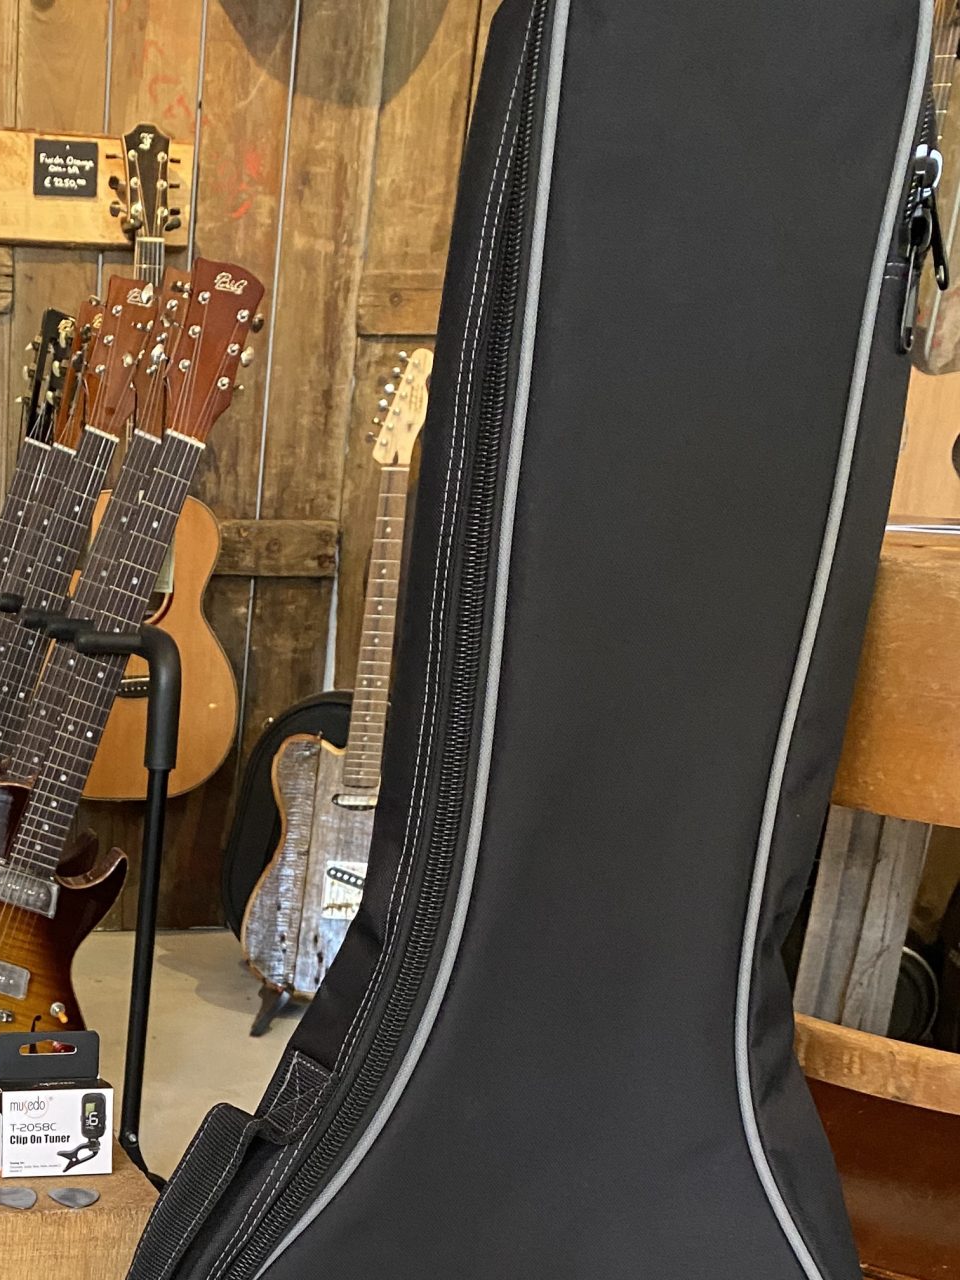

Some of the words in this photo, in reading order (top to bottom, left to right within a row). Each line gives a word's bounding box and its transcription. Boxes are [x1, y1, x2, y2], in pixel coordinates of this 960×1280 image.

[9, 1096, 46, 1114] musedo
[9, 1134, 28, 1146] Clip
[30, 1134, 42, 1145] On
[44, 1133, 71, 1144] Tuner
